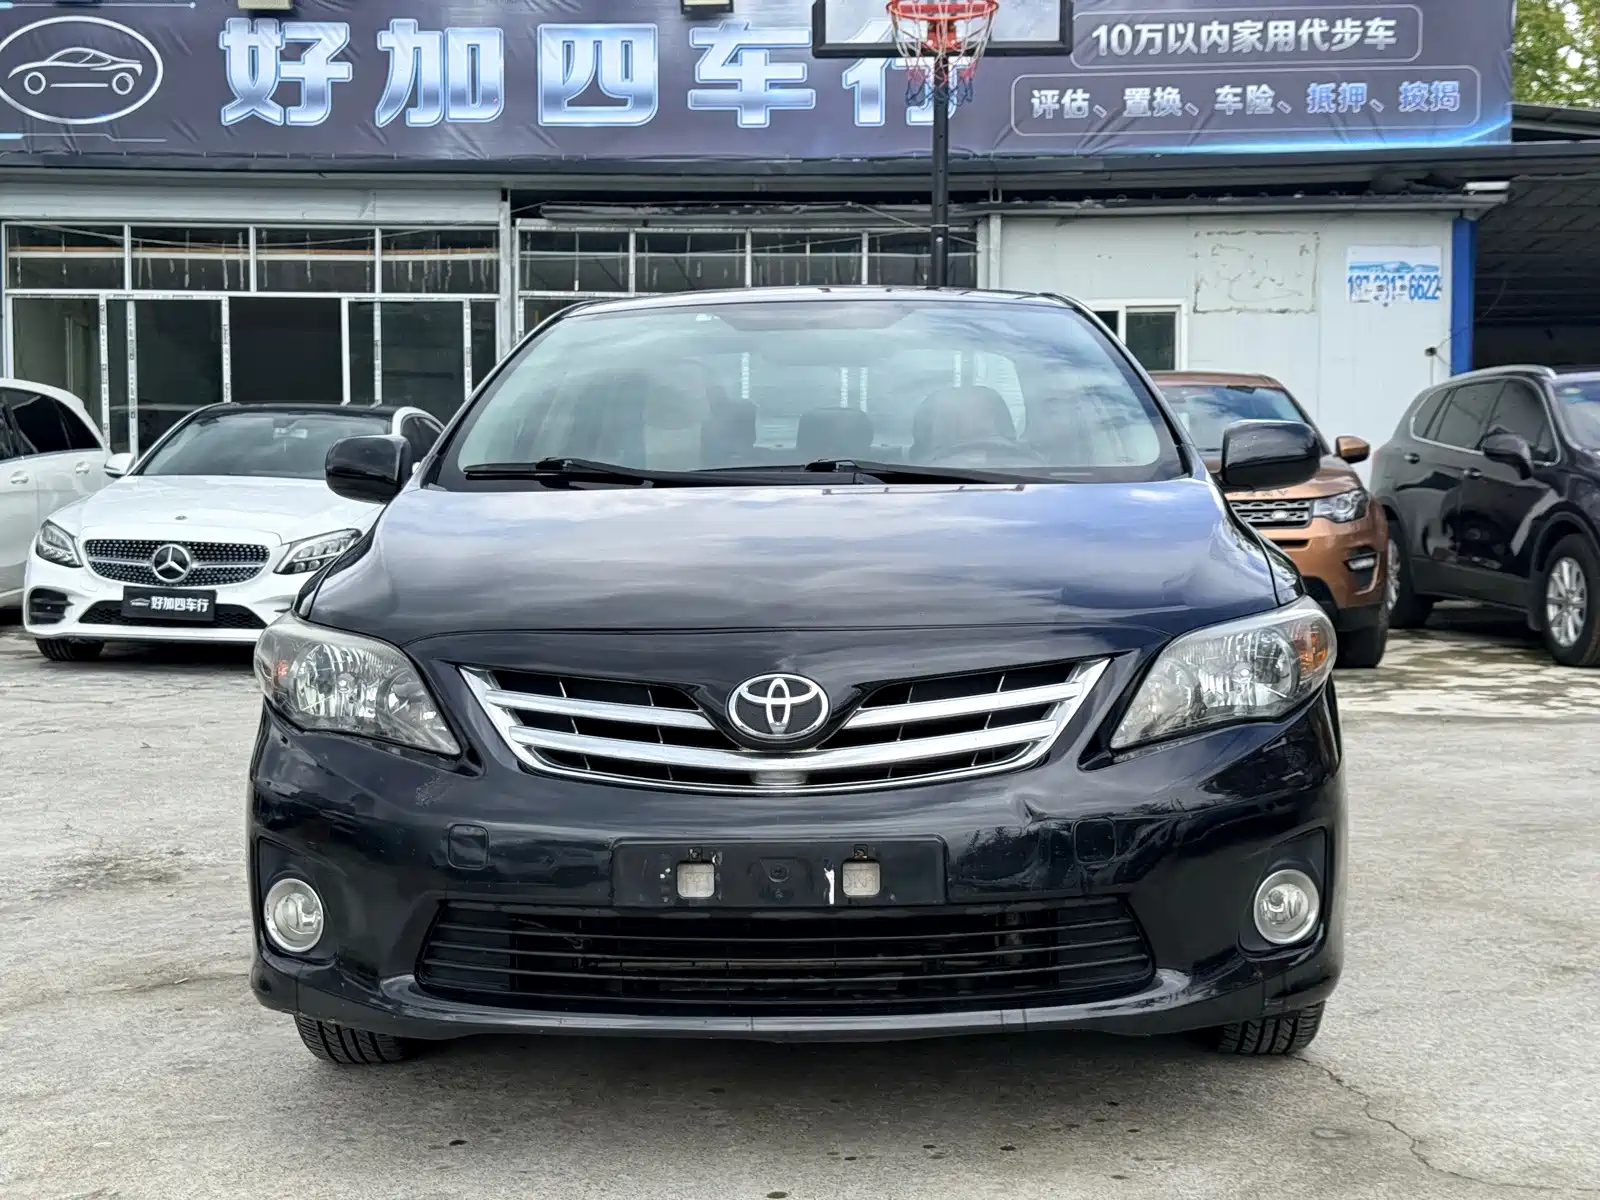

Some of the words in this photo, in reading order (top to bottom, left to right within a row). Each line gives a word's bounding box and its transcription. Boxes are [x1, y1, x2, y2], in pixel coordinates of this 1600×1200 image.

[1091, 17, 1397, 56] 10万以内家用代步车
[219, 18, 975, 127] 好加四车行
[151, 596, 209, 612] 好加四车行
